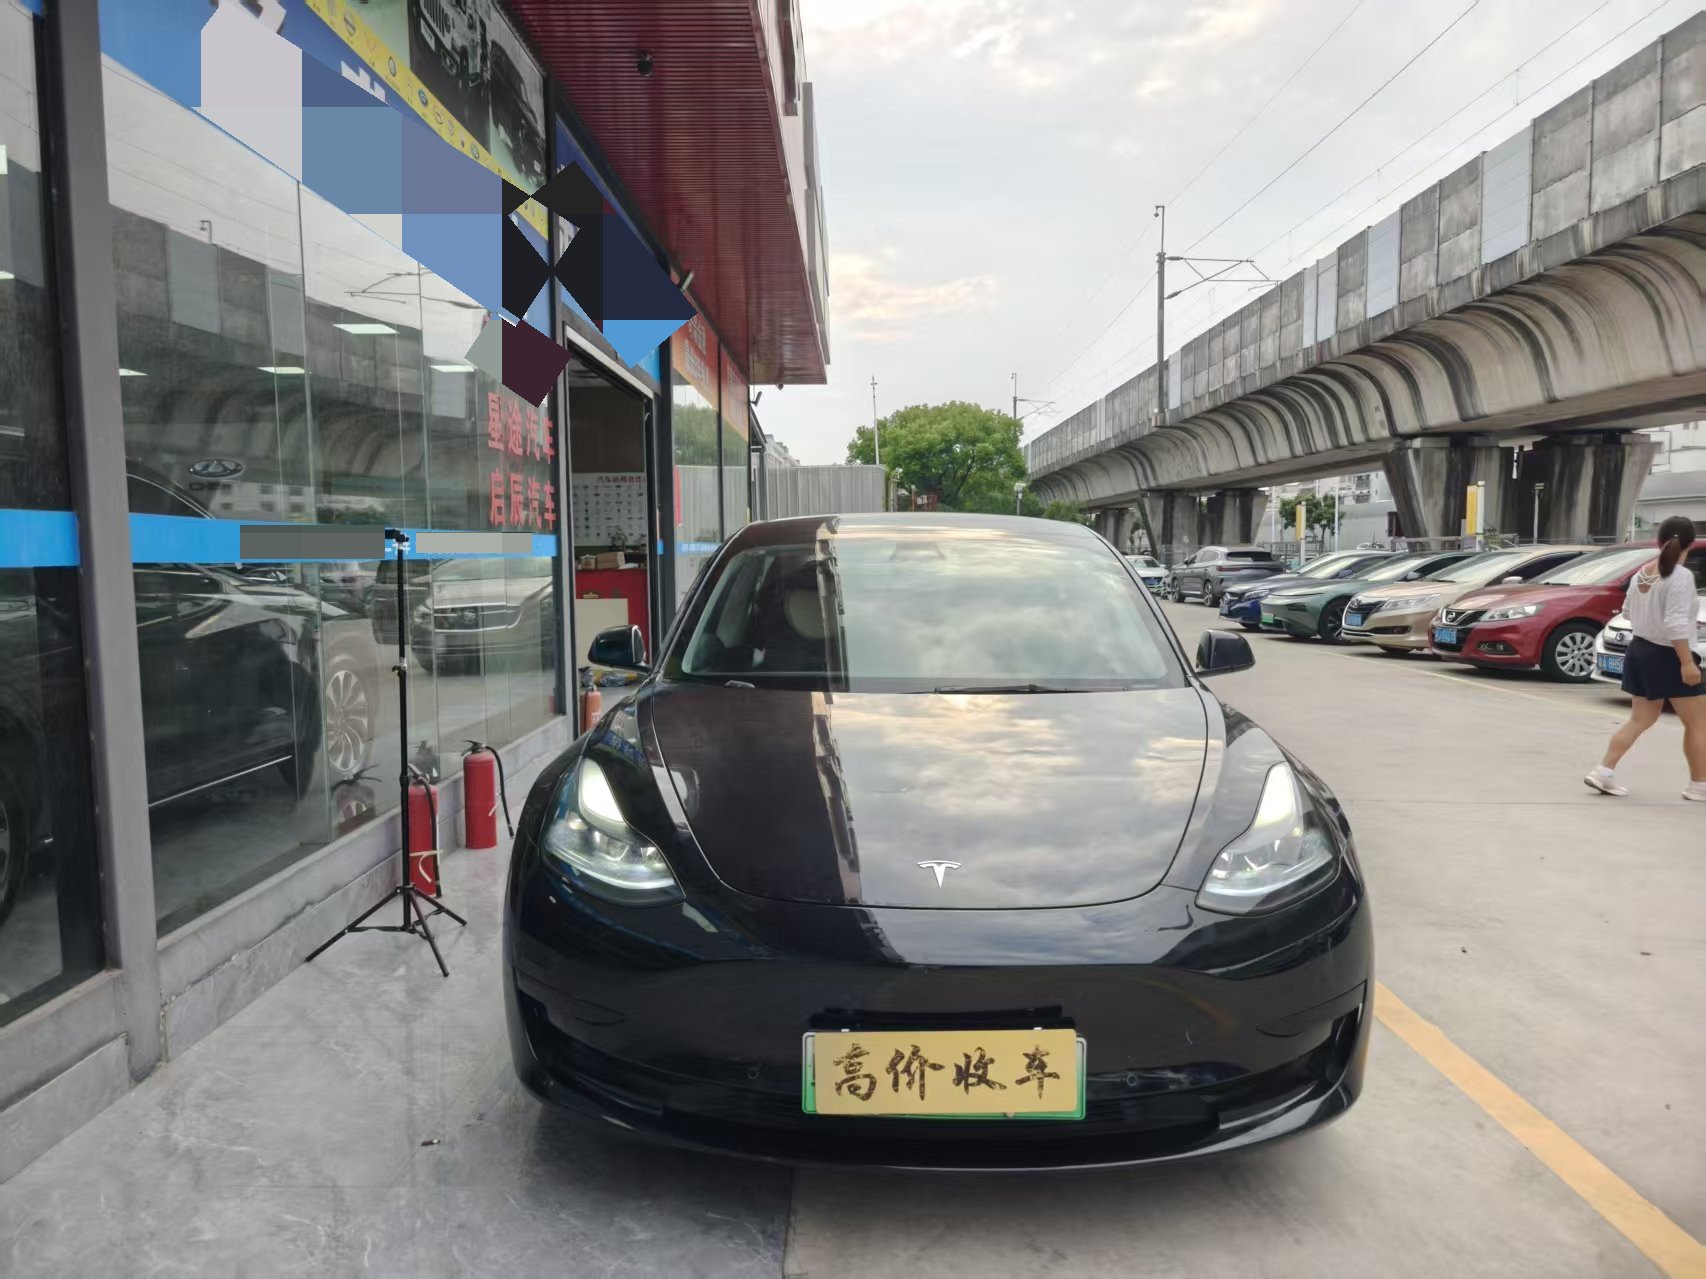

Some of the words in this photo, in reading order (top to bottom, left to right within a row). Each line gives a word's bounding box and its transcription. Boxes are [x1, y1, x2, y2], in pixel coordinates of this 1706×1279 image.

[489, 468, 556, 531] 启辰汽车
[833, 1042, 1061, 1101] 高价收车
